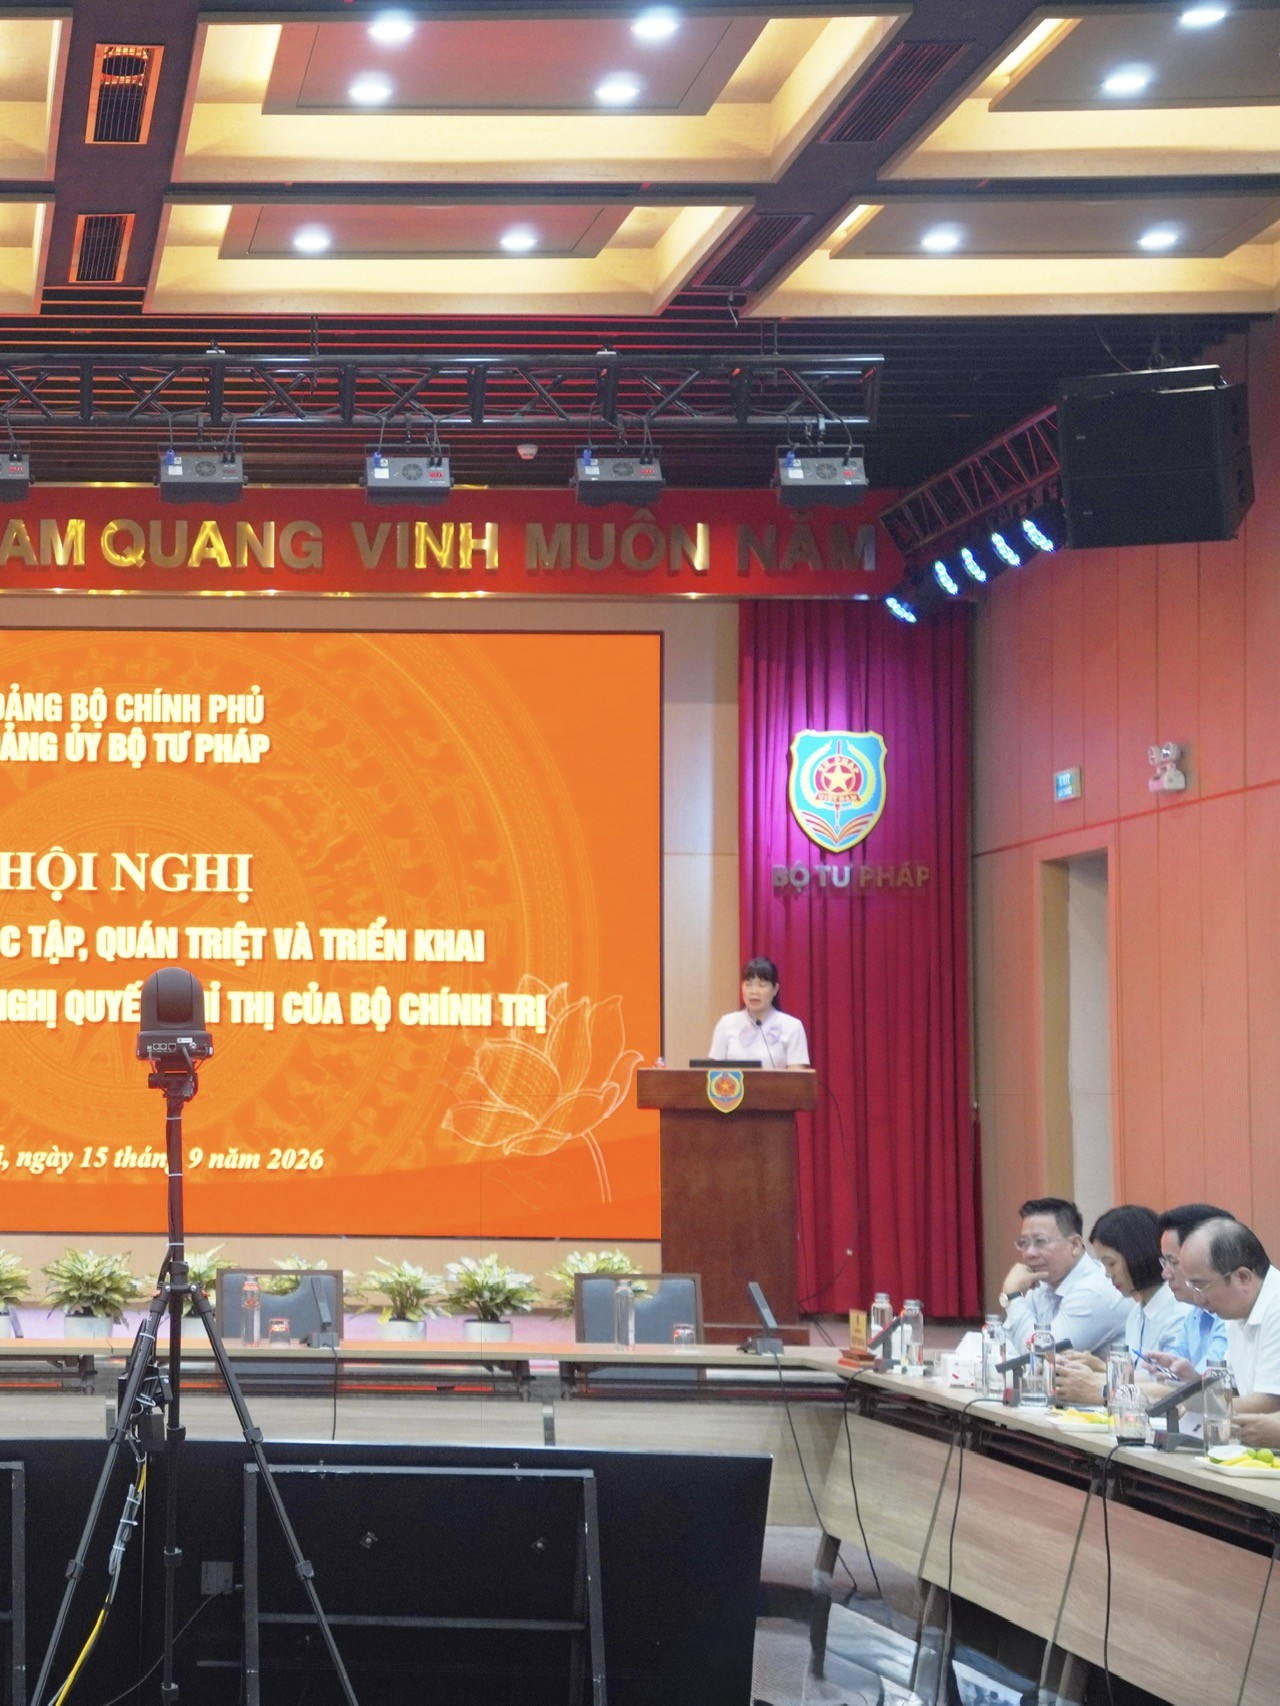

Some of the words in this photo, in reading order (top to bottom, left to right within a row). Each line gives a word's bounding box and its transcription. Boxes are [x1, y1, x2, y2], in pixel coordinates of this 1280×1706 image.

[101, 519, 323, 569] QUANG
[351, 521, 499, 570] VINH
[526, 509, 710, 572] MUÔN
[737, 509, 876, 572] NĂM
[70, 686, 108, 729] BỘ
[115, 687, 201, 724] CHÍNH
[208, 684, 265, 724] PHỦ
[64, 722, 102, 762] ỦY
[108, 726, 147, 769] BỘ
[152, 730, 192, 763] TƯ
[194, 728, 271, 764] PHÁP
[110, 852, 254, 904] NGHỊ
[772, 860, 811, 894] BỘ
[859, 862, 930, 888] PHÁP
[27, 919, 89, 963] TẬP,
[95, 919, 179, 962] QUÁN
[184, 920, 268, 967] TRIỆT
[272, 921, 314, 961] VÀ
[319, 915, 407, 962] TRIỂN
[413, 928, 485, 963] KHAI
[64, 980, 144, 1026] QUYẾ
[226, 990, 275, 1031] THỊ
[281, 981, 344, 1025] CỦA
[350, 985, 392, 1032] BỘ
[398, 986, 493, 1027] CHÍNH
[498, 993, 547, 1034] TRỊ
[15, 1145, 74, 1173] ngày
[79, 1146, 109, 1168] 15
[113, 1145, 170, 1175] thán
[188, 1147, 204, 1169] 9
[208, 1147, 261, 1170] năm
[266, 1148, 324, 1171] 2026
